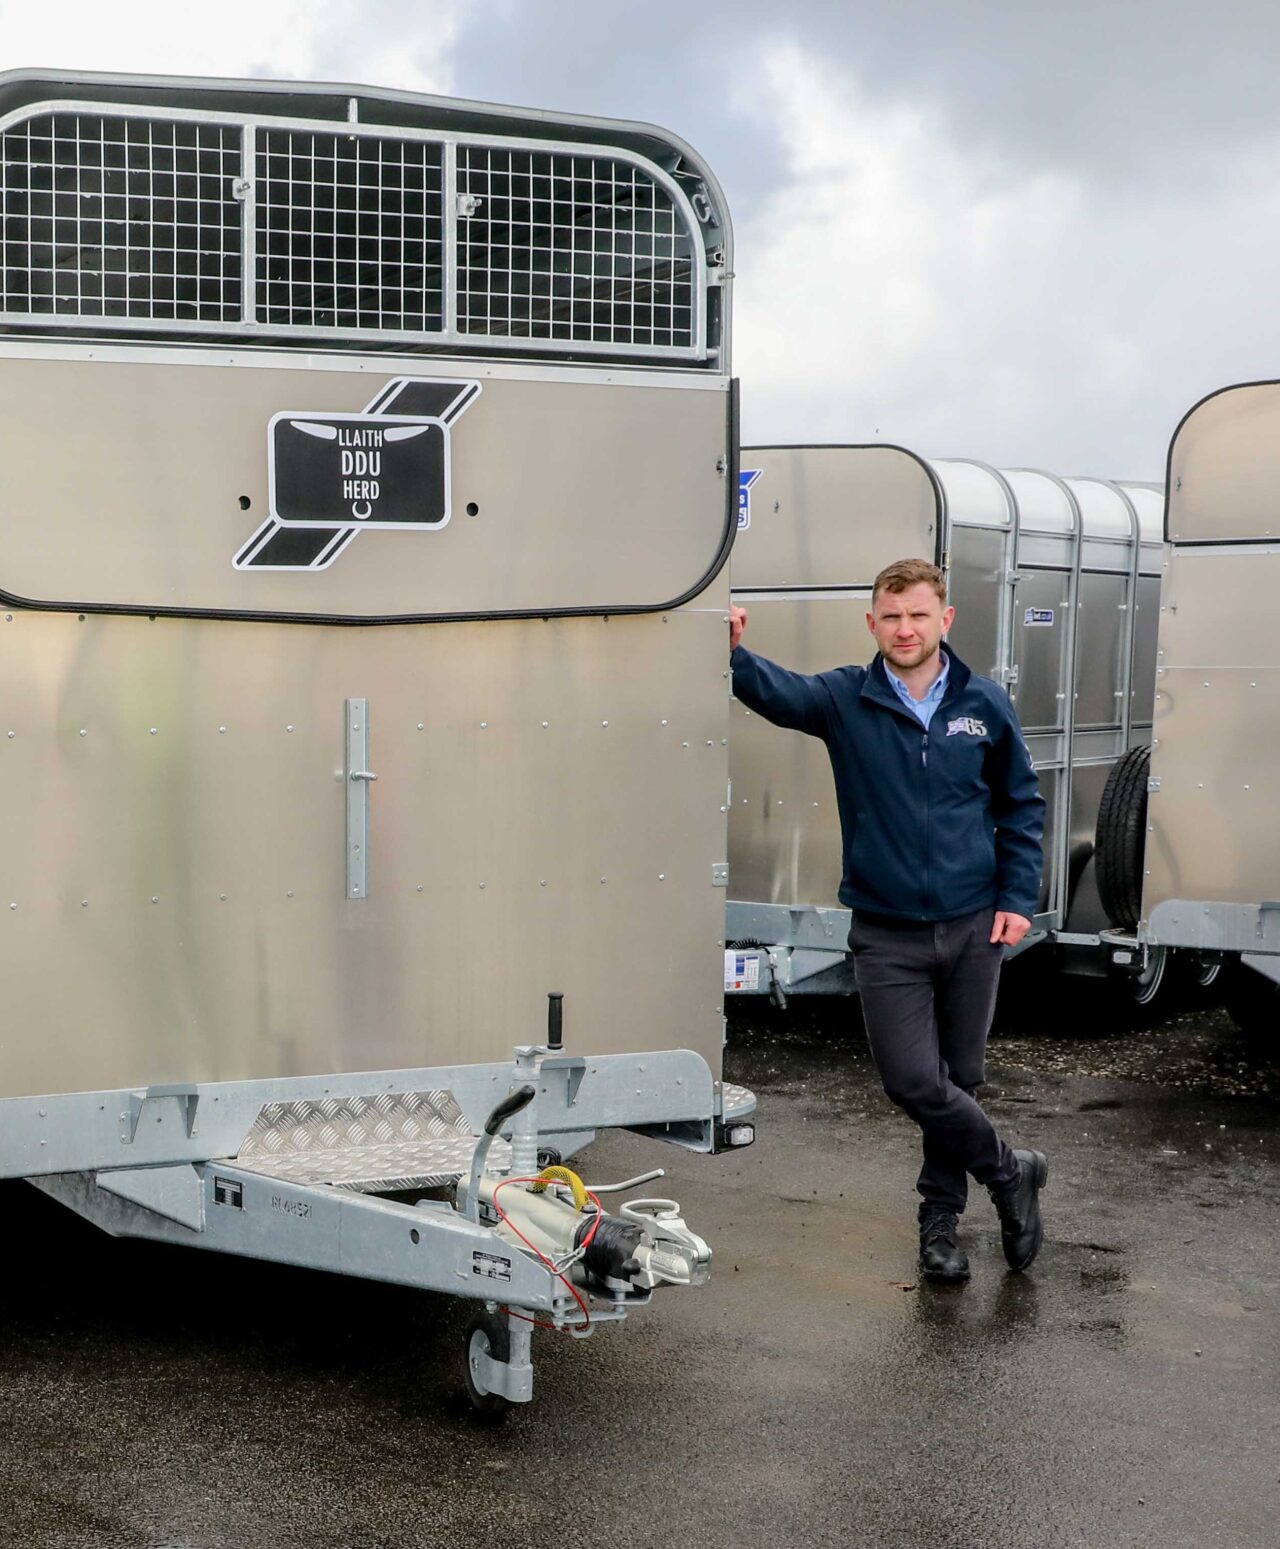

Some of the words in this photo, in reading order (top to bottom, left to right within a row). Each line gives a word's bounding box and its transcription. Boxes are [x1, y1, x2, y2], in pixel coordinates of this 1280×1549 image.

[338, 428, 383, 448] LLAITH
[341, 450, 381, 477] DDU
[343, 480, 380, 500] HERD
[967, 717, 988, 737] 65
